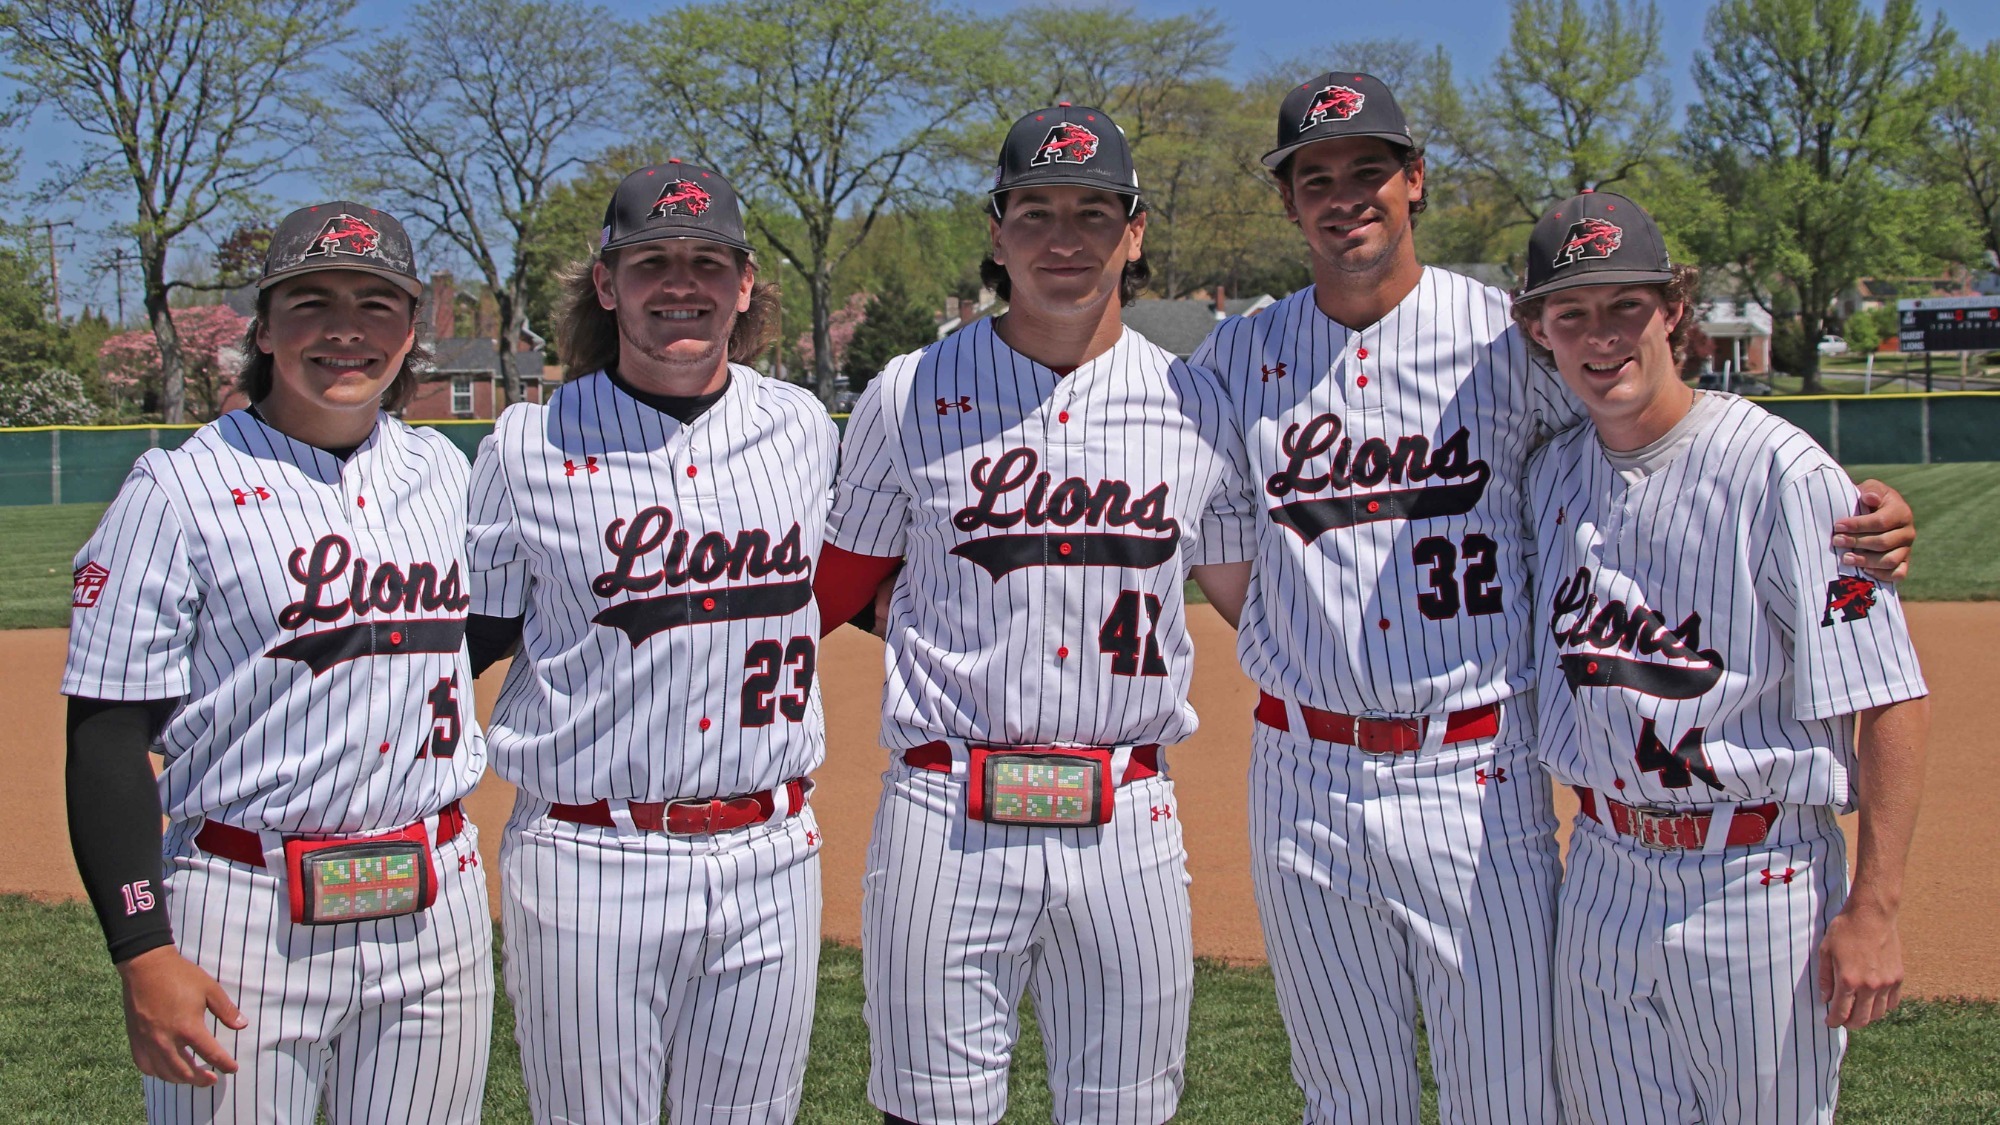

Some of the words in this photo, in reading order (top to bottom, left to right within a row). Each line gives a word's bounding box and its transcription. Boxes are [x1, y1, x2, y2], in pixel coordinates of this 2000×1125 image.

[1901, 331, 1925, 340] GUEST
[1903, 341, 1925, 350] LIONS
[953, 447, 1181, 532] Lions
[1266, 413, 1491, 497] Lions
[278, 534, 470, 631] Lions
[592, 506, 812, 598] Lions
[1412, 533, 1504, 621] 32
[1551, 566, 1725, 669] Lions
[740, 635, 816, 728] 23
[121, 879, 156, 916] 15
